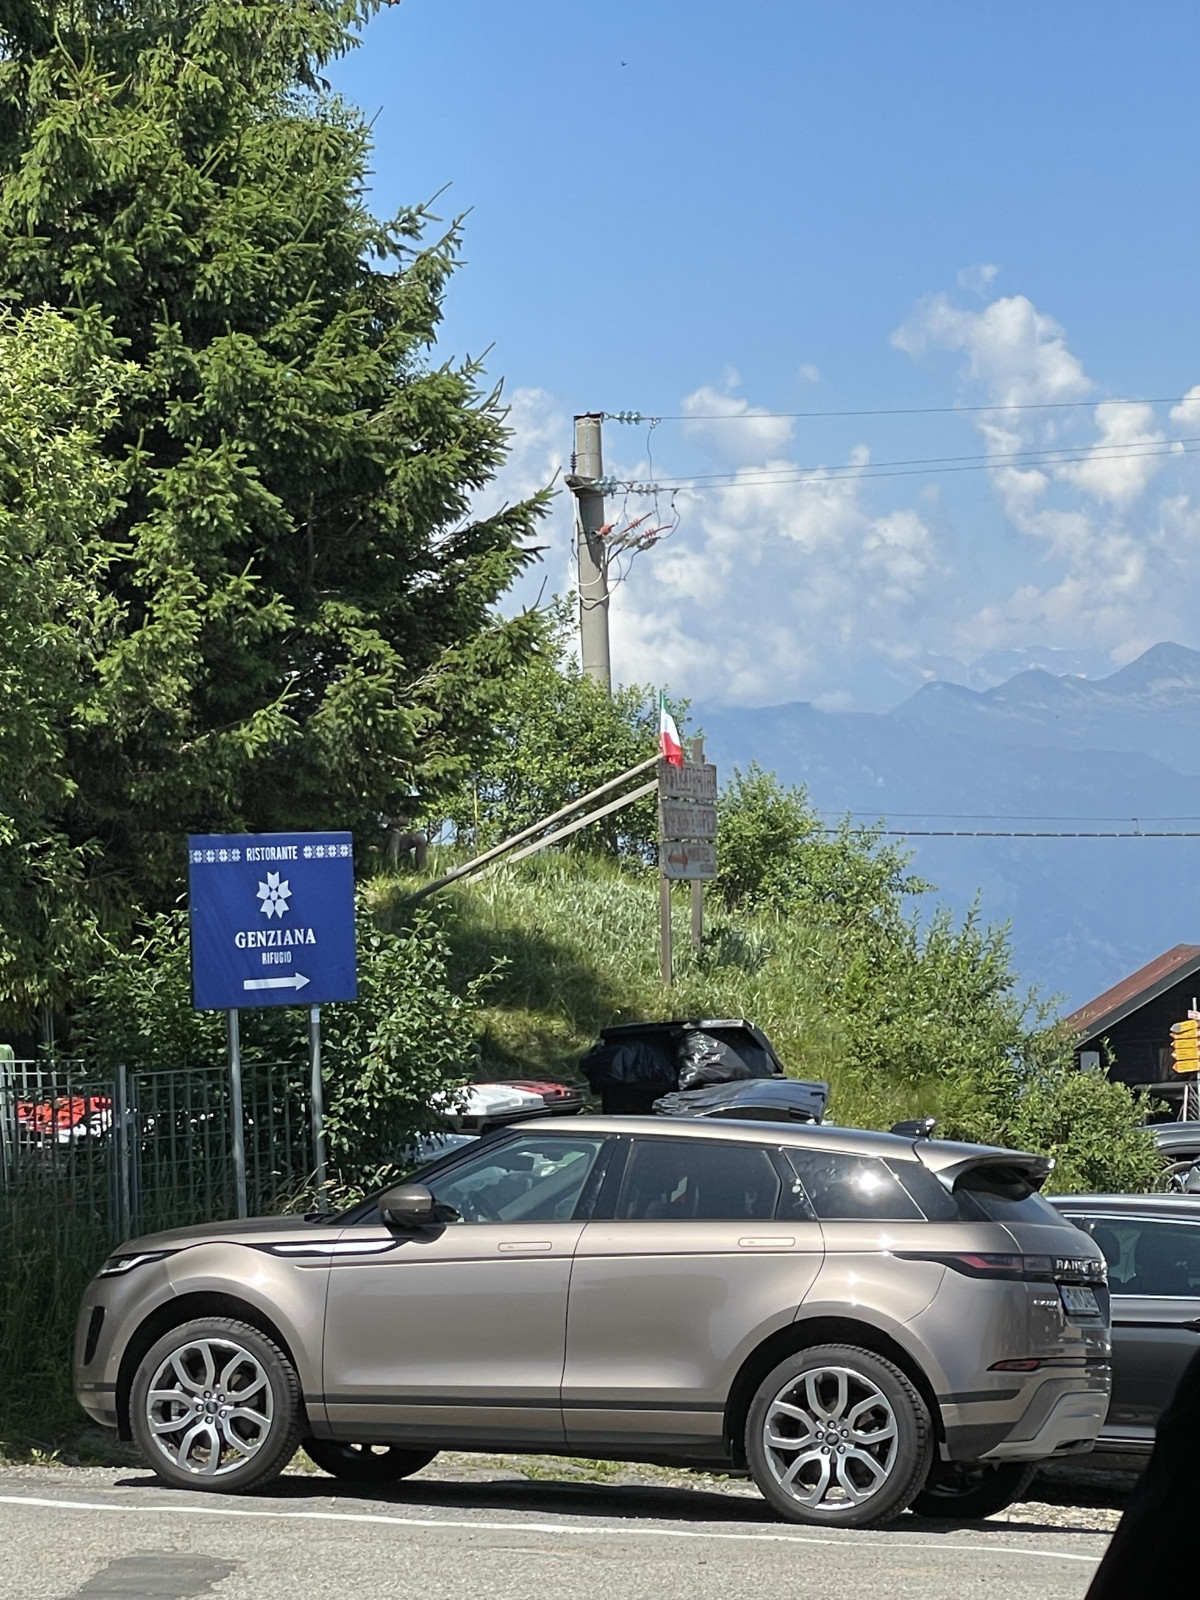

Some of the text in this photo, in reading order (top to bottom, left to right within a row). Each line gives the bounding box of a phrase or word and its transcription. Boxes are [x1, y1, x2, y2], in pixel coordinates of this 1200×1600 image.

[246, 846, 298, 861] RISTORANTE
[234, 928, 316, 949] GENZIANA
[261, 951, 292, 965] RIFUGIO
